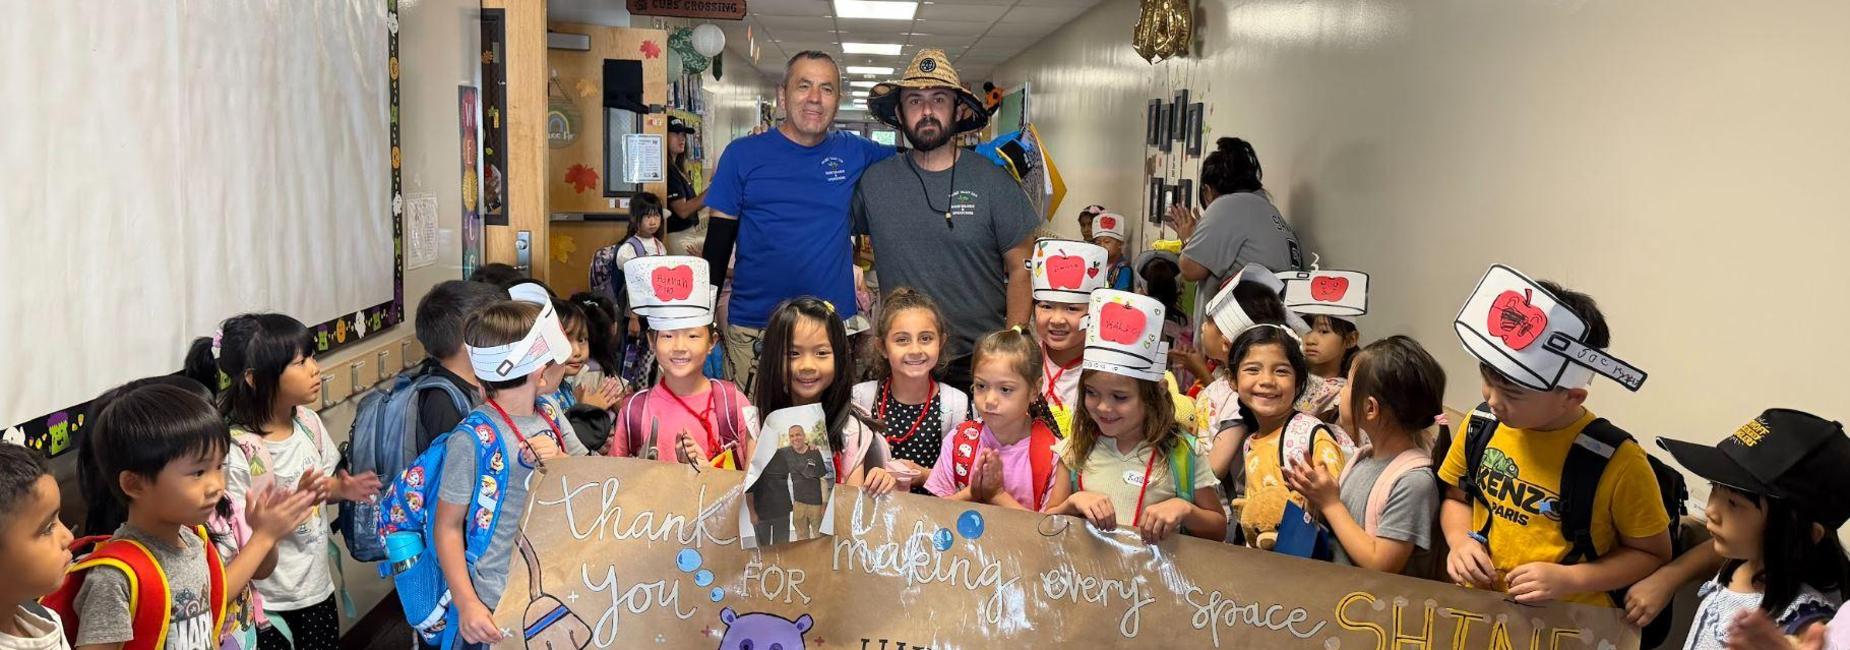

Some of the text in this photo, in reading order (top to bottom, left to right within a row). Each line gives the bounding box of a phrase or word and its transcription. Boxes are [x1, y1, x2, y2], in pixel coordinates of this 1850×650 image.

[683, 0, 737, 13] CROSSING
[538, 475, 738, 549] thank
[1490, 500, 1530, 527] PARIS
[581, 561, 812, 649] you FOR
[831, 520, 1021, 625] making
[1039, 568, 1156, 639] every
[1184, 585, 1328, 649] space
